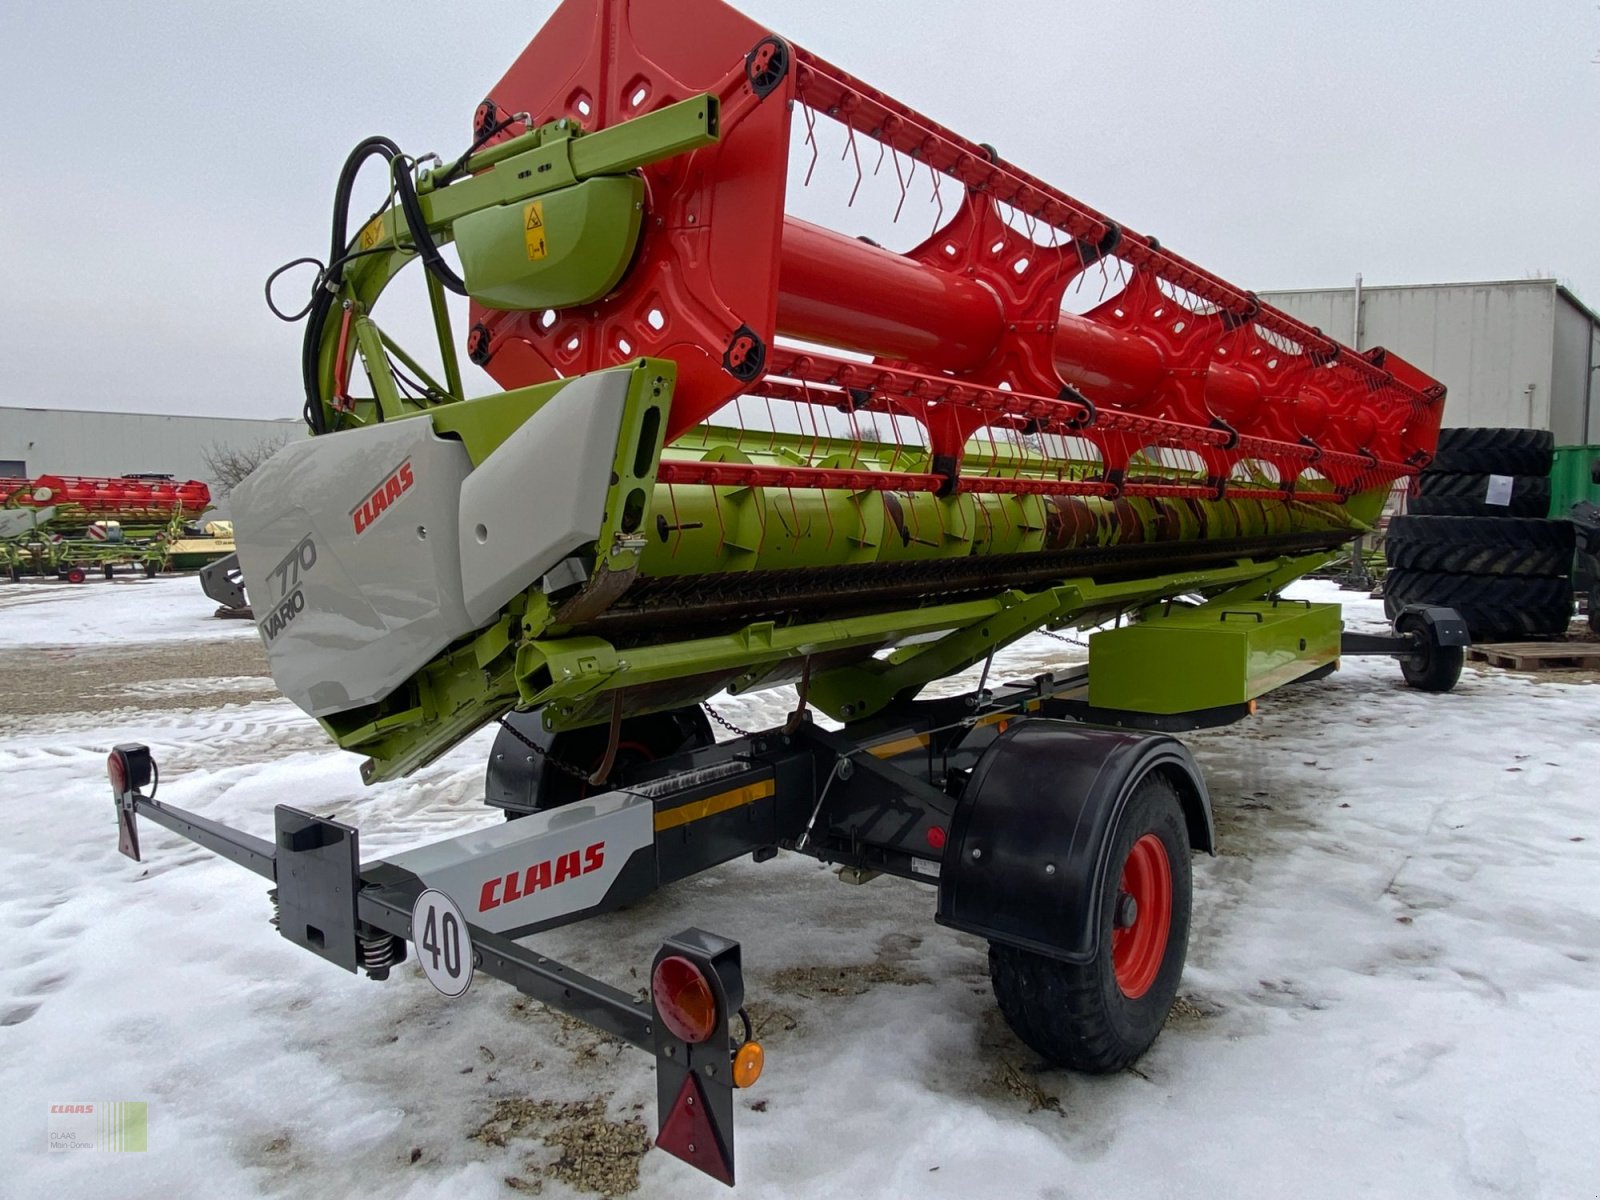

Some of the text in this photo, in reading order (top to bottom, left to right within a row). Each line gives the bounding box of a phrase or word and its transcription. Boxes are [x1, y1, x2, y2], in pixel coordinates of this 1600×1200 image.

[353, 462, 414, 535] CLAAS
[275, 538, 317, 597] 770
[263, 590, 305, 641] VARIO
[478, 840, 606, 913] CLAAS
[422, 904, 461, 979] 40
